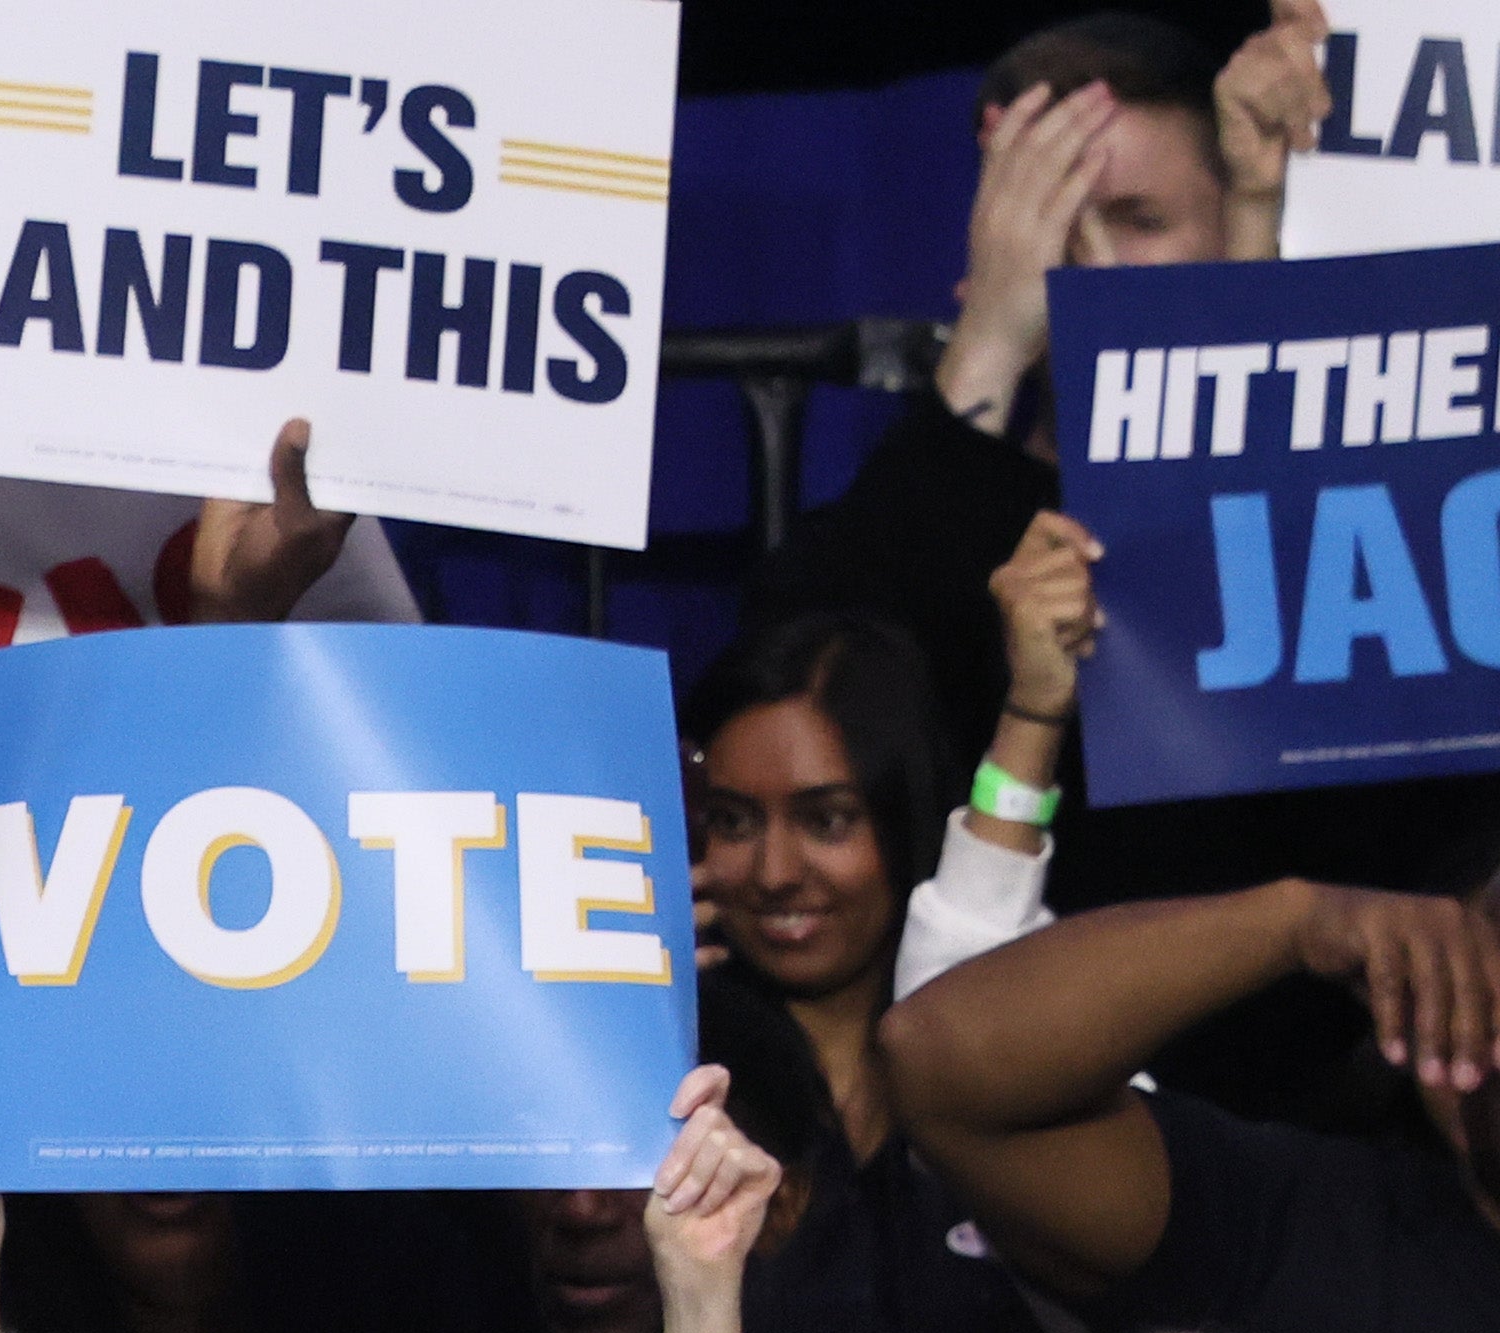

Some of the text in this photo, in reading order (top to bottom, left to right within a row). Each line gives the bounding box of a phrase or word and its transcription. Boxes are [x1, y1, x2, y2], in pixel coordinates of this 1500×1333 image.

[117, 51, 476, 213] LET'S
[1317, 32, 1500, 165] LA
[319, 238, 632, 405] THIS
[1088, 324, 1490, 464] HIT THE
